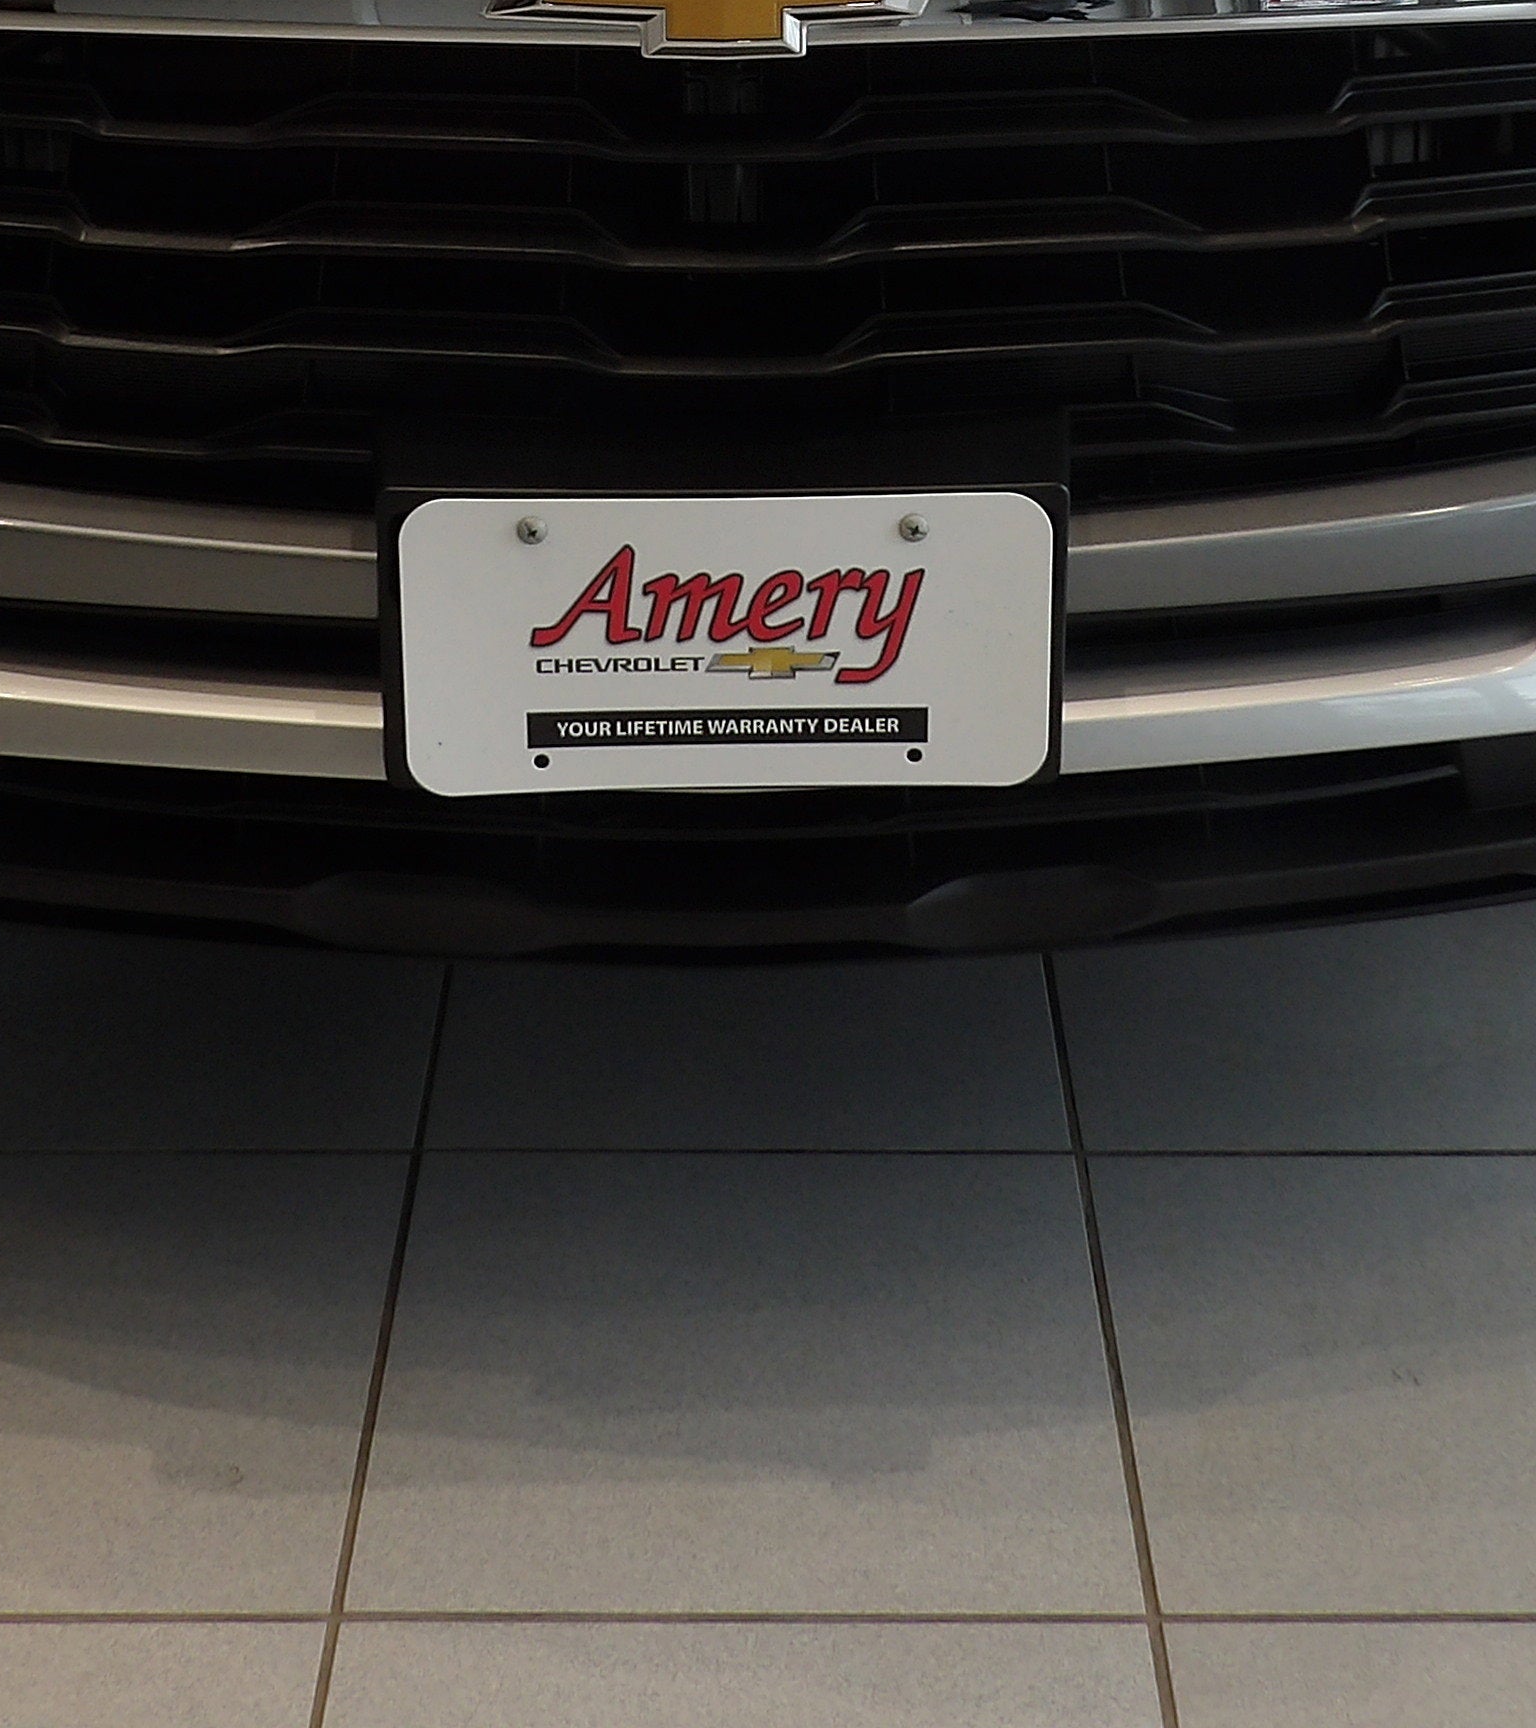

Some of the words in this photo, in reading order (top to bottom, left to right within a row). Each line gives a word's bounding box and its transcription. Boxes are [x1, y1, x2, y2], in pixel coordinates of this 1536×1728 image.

[530, 543, 926, 684] Amery
[535, 656, 705, 674] CHEVROLET
[557, 721, 612, 738] YOUR
[616, 720, 703, 737] LIFETIME
[707, 718, 820, 735] WARRANTY
[824, 717, 900, 734] DEALER
